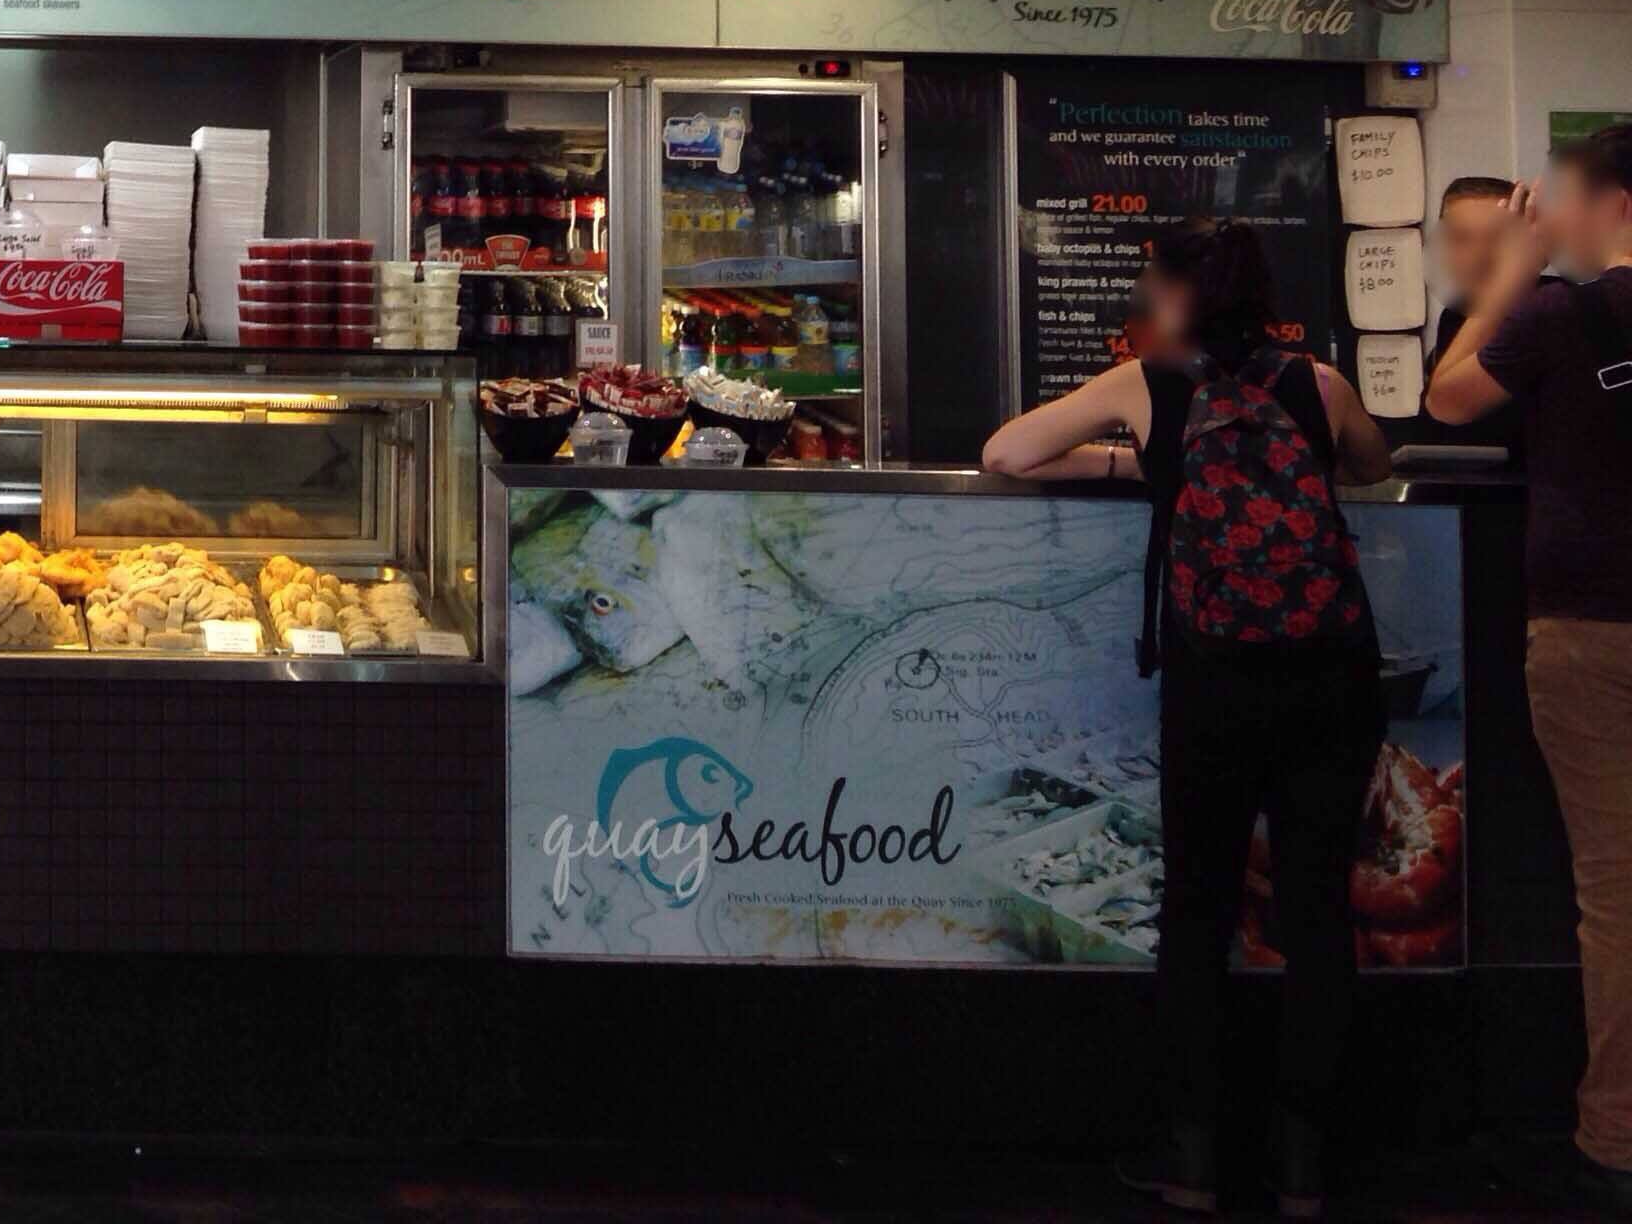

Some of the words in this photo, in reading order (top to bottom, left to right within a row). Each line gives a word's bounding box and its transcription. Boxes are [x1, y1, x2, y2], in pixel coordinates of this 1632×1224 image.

[1013, 2, 1067, 23] Since
[1071, 6, 1118, 28] 1975
[1188, 112, 1229, 127] takes
[1234, 112, 1270, 127] time
[1049, 130, 1076, 142] and
[1081, 133, 1101, 143] we
[1104, 133, 1176, 145] guarantee
[1181, 130, 1291, 148] satisfaction
[1104, 152, 1139, 166] with
[1144, 154, 1188, 169] every
[1036, 198, 1066, 208] mixed
[1069, 198, 1087, 210] grill
[1093, 194, 1147, 213] 21.00
[1063, 243, 1102, 256] octopus
[1104, 243, 1112, 254] &
[1114, 243, 1140, 256] chips
[1038, 277, 1060, 289] king
[1062, 278, 1098, 289] prawns
[1100, 277, 1108, 287] &
[1039, 311, 1056, 321] fish
[1059, 311, 1067, 321] &
[1069, 311, 1096, 322] chips
[891, 709, 960, 724] SOUTH
[996, 710, 1052, 724] HEAD
[727, 892, 761, 905] Fresh
[764, 893, 813, 905] Cooked
[816, 894, 868, 907] Seafood
[872, 897, 883, 907] at
[887, 895, 908, 907] the
[911, 897, 945, 910] Quay
[951, 896, 984, 908] Since
